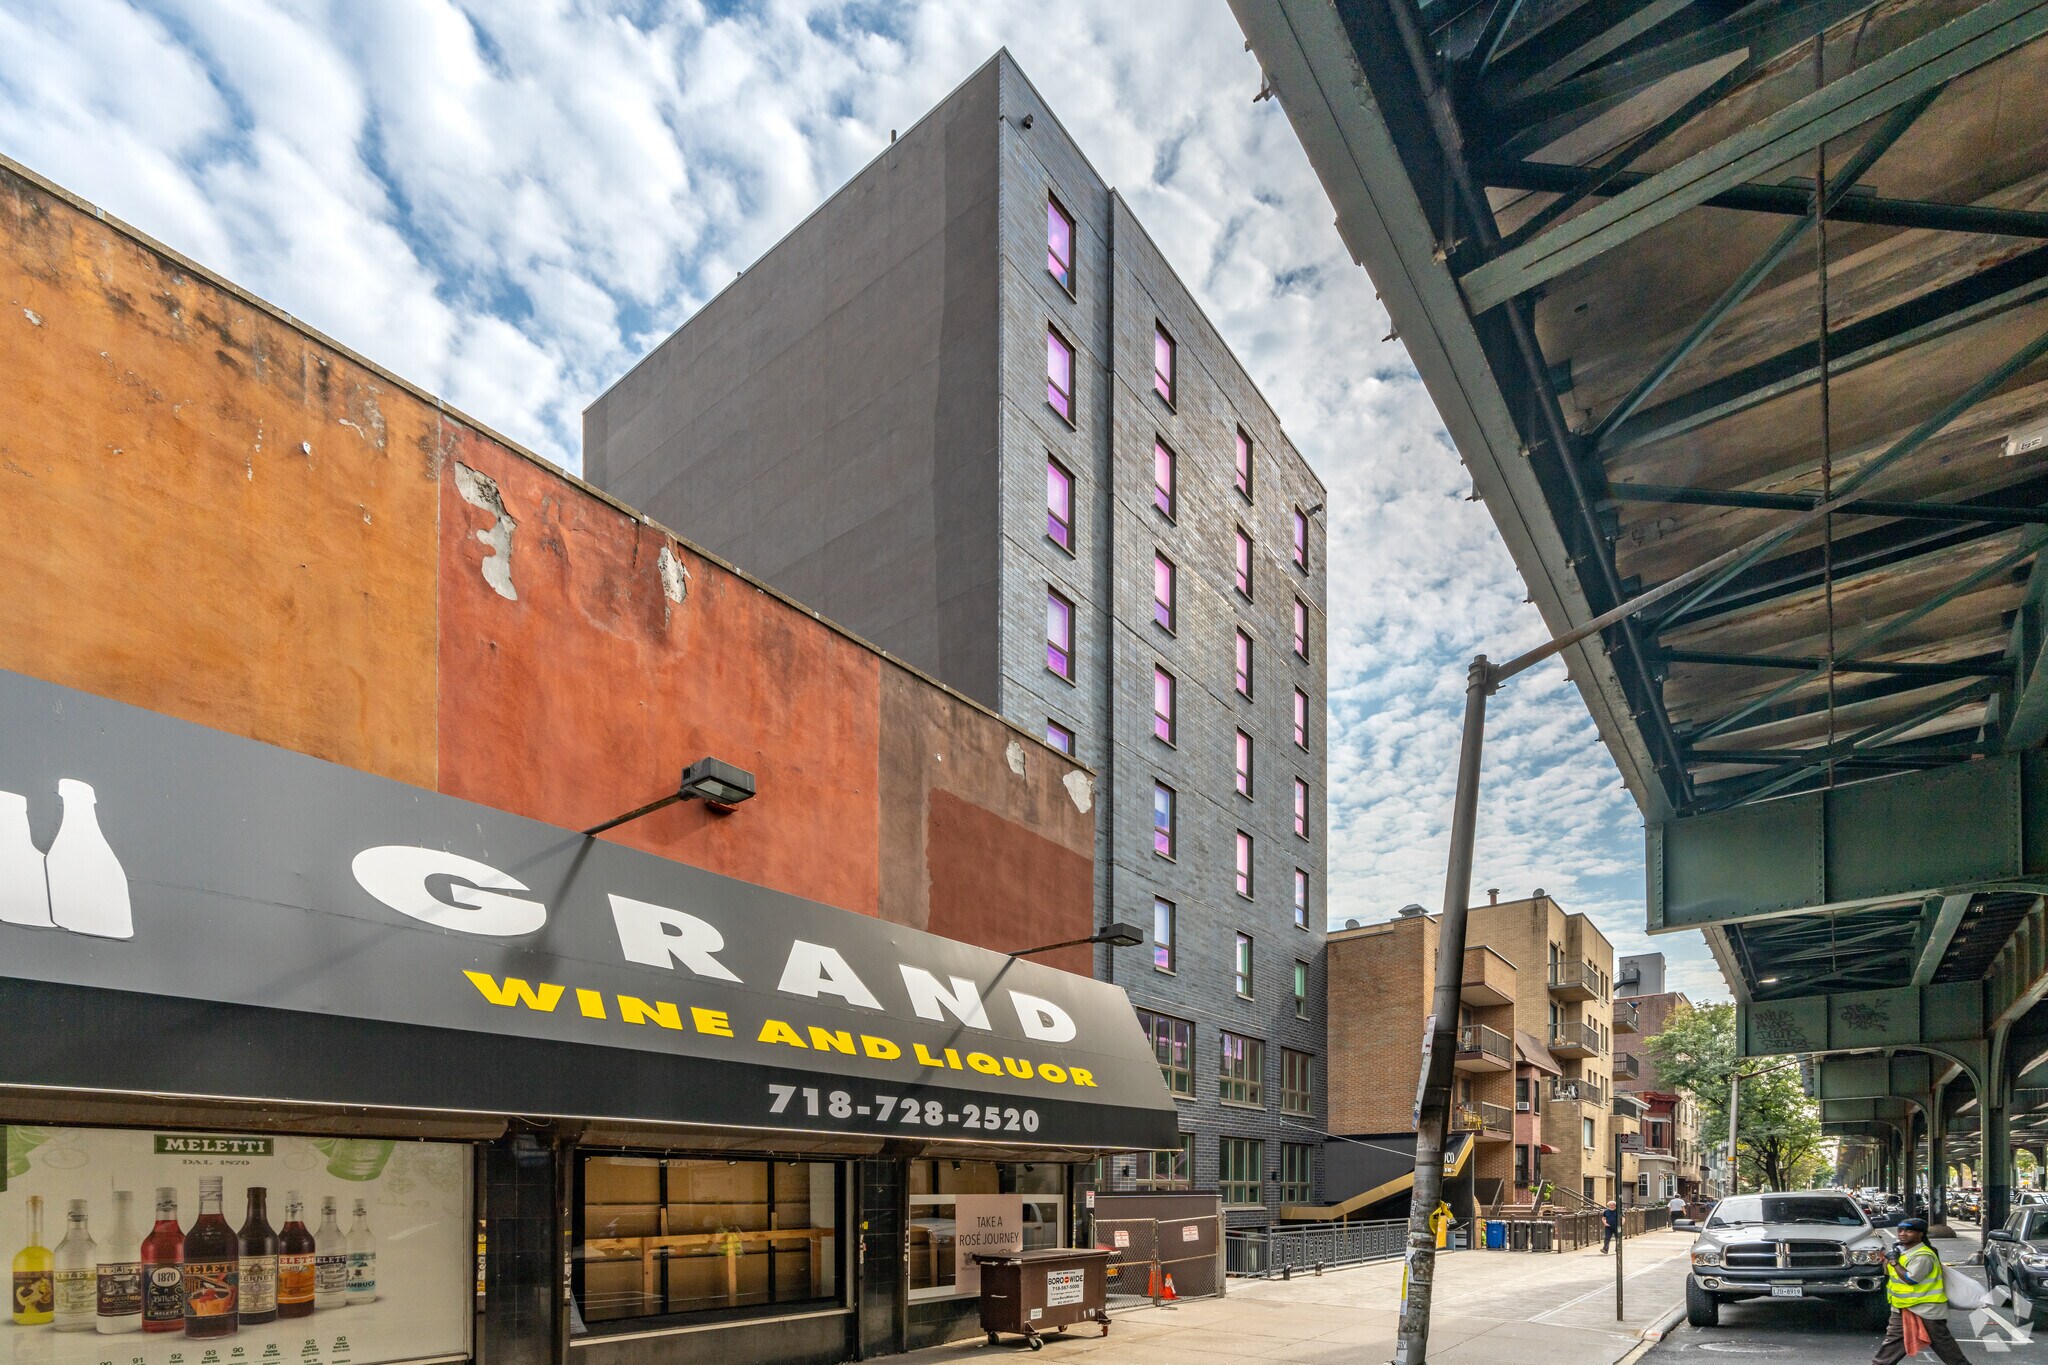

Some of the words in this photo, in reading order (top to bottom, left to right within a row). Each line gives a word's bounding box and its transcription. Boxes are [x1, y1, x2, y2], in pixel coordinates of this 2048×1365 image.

[352, 845, 1077, 1043] GRAND
[462, 970, 734, 1038] WINE
[757, 1019, 902, 1060] AND
[912, 1042, 1098, 1088] LIQUOR
[768, 1084, 1040, 1133] 718-728-2520
[165, 1138, 265, 1153] MELETTI
[976, 1216, 996, 1228] TAKE
[997, 1216, 1003, 1227] A
[959, 1231, 981, 1246] ROSÉ
[982, 1232, 1020, 1245] JOURNEY
[157, 1272, 176, 1282] 1870
[1048, 1276, 1064, 1285] BORO
[1069, 1275, 1084, 1283] WIDE
